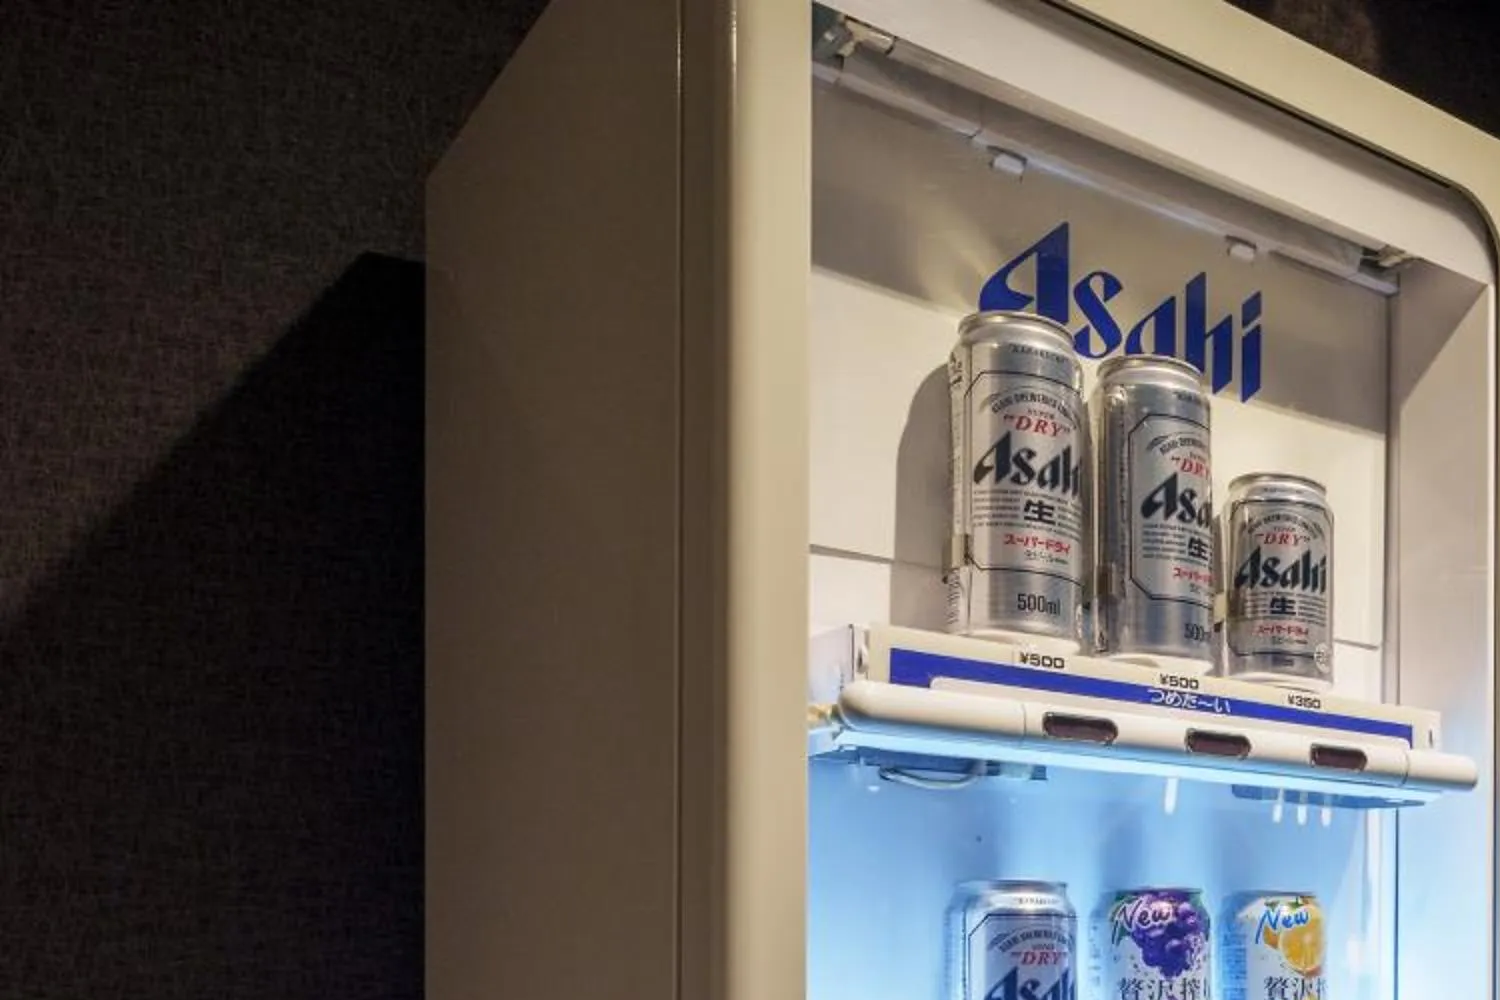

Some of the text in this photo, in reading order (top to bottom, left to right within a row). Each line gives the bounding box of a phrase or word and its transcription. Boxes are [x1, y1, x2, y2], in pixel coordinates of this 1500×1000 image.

[980, 222, 1262, 403] Asahi
[974, 430, 1081, 497] Asah
[1023, 499, 1057, 526] 生
[1235, 547, 1327, 594] Asahi
[1017, 592, 1061, 615] 500ml
[1270, 596, 1297, 614] 生
[1019, 651, 1065, 670] ¥500
[1159, 673, 1200, 690] ¥500
[1110, 899, 1171, 945] New
[1255, 909, 1309, 944] New
